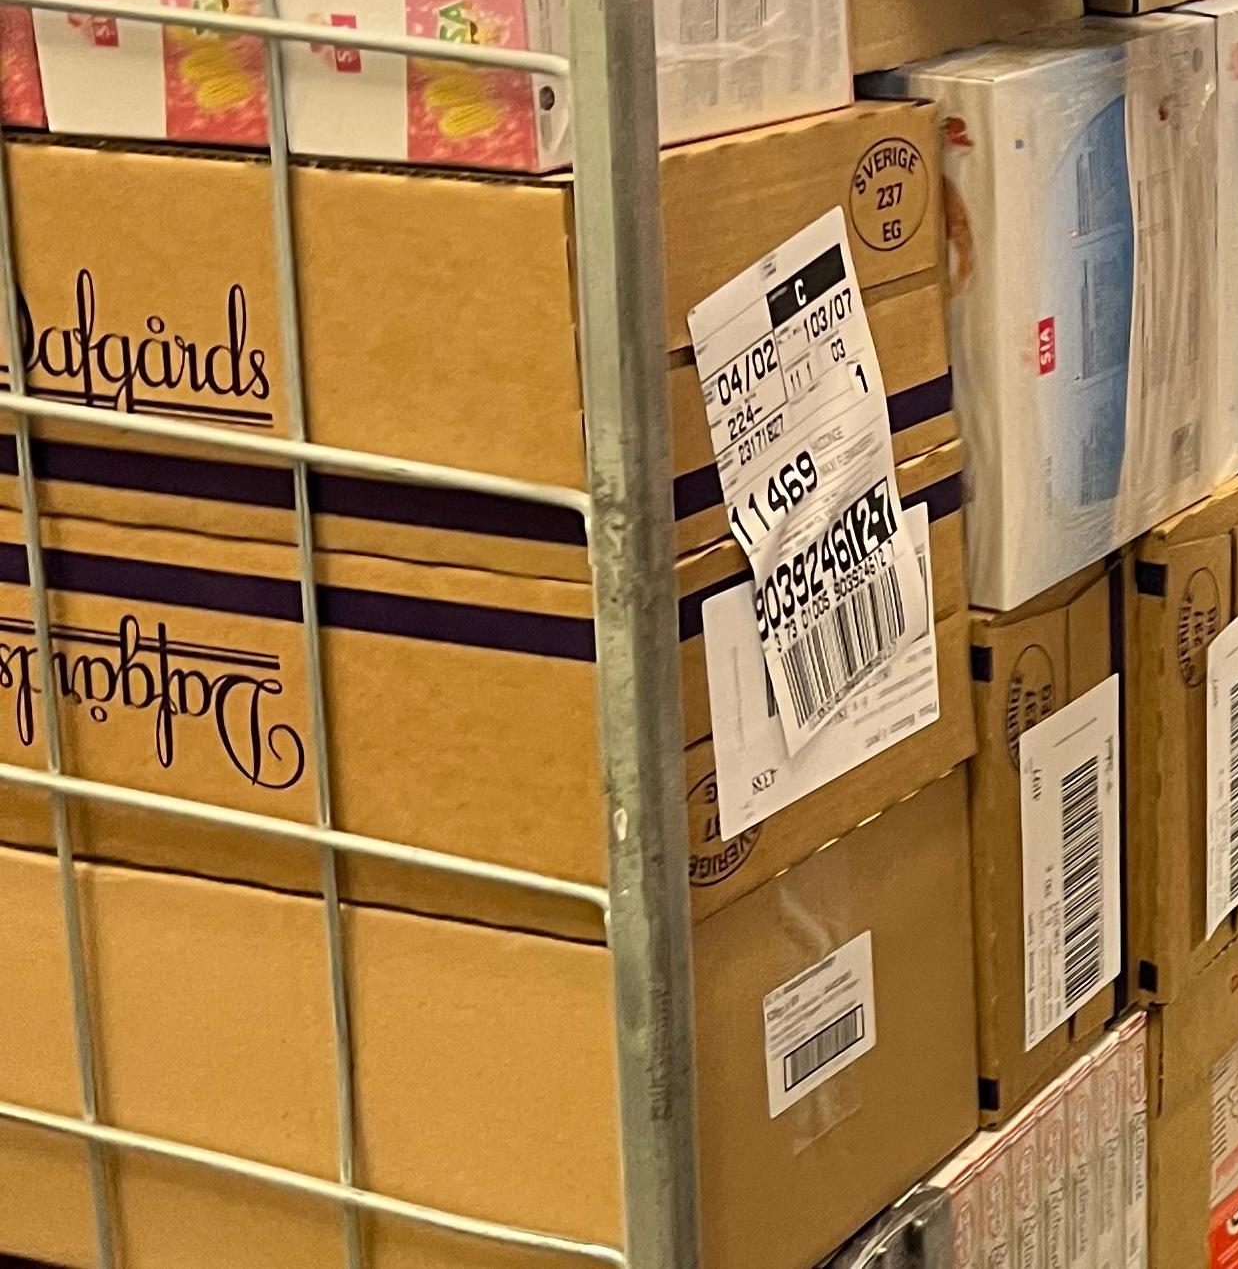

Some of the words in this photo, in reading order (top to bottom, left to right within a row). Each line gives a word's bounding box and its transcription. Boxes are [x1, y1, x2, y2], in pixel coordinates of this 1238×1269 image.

[854, 146, 919, 195] SVERIGE
[876, 181, 903, 211] 237
[882, 219, 902, 242] EG
[795, 278, 807, 307] C
[830, 338, 846, 363] 03
[1038, 326, 1053, 367] SIA
[717, 338, 778, 406] 04/02
[854, 364, 869, 394] 1
[727, 404, 763, 441] 224-
[0, 615, 305, 790] Dafgårds
